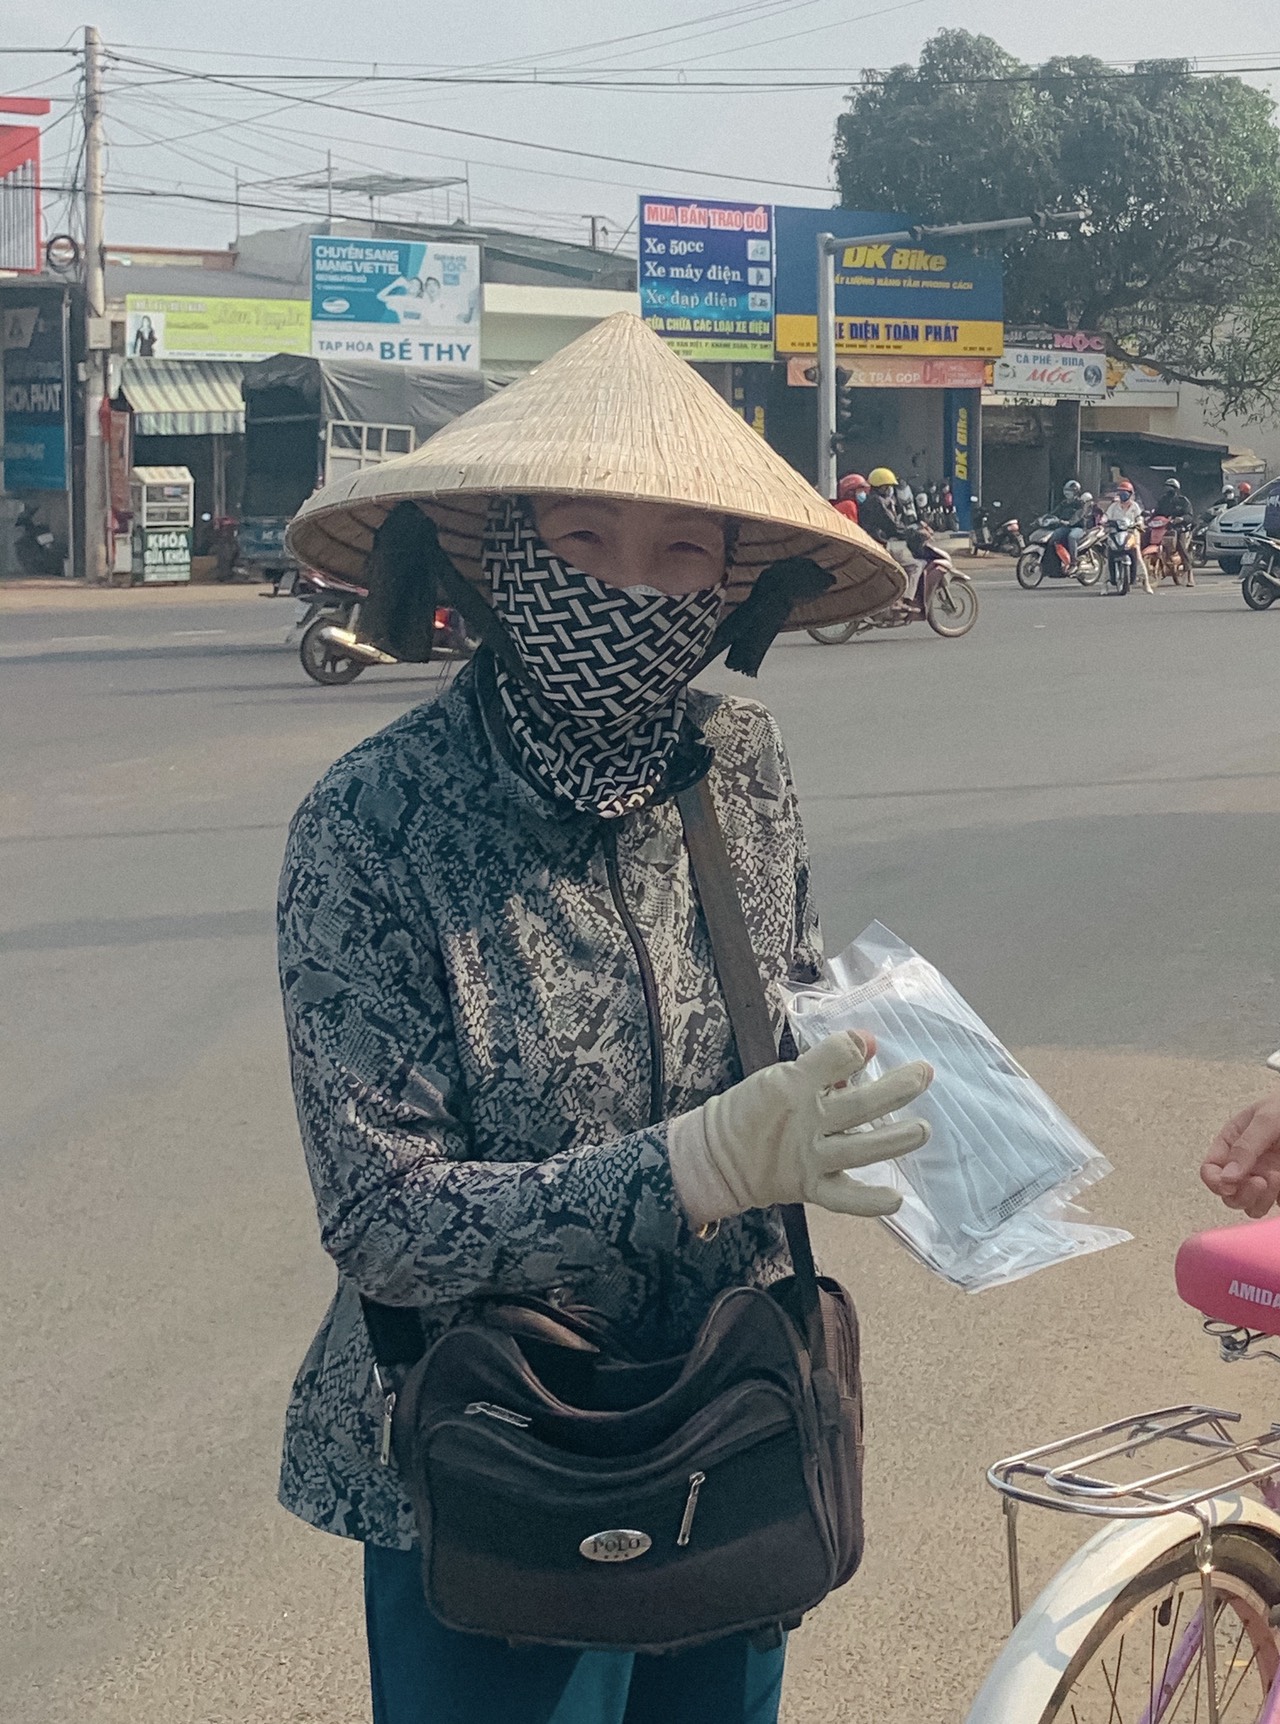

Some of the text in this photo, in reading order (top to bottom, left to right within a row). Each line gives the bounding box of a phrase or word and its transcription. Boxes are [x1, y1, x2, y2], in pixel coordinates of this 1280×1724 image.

[644, 204, 678, 225] MUA
[678, 205, 708, 228] BÁN
[710, 209, 743, 230] TRAO
[364, 250, 399, 261] SANG
[645, 238, 704, 255] Xe 50cc
[842, 244, 947, 271] DK Bike
[316, 260, 401, 275] MẠNG VIETTEL
[645, 261, 741, 284] Xe máy điện
[646, 289, 737, 311] Xe đạp điện
[694, 318, 713, 332] CÁC
[713, 321, 735, 334] LOẠI
[736, 321, 747, 333] XE
[834, 323, 844, 340] E
[925, 320, 959, 342] PHÁT
[318, 341, 342, 354] TẠP
[379, 338, 412, 360] BÉ
[419, 342, 471, 361] THY
[1054, 332, 1105, 352] MỘC
[1033, 354, 1051, 367] PHÊ
[1026, 366, 1077, 385] MỘC
[955, 448, 968, 480] DK
[147, 531, 188, 548] KHÓA
[593, 1538, 640, 1554] POLO
